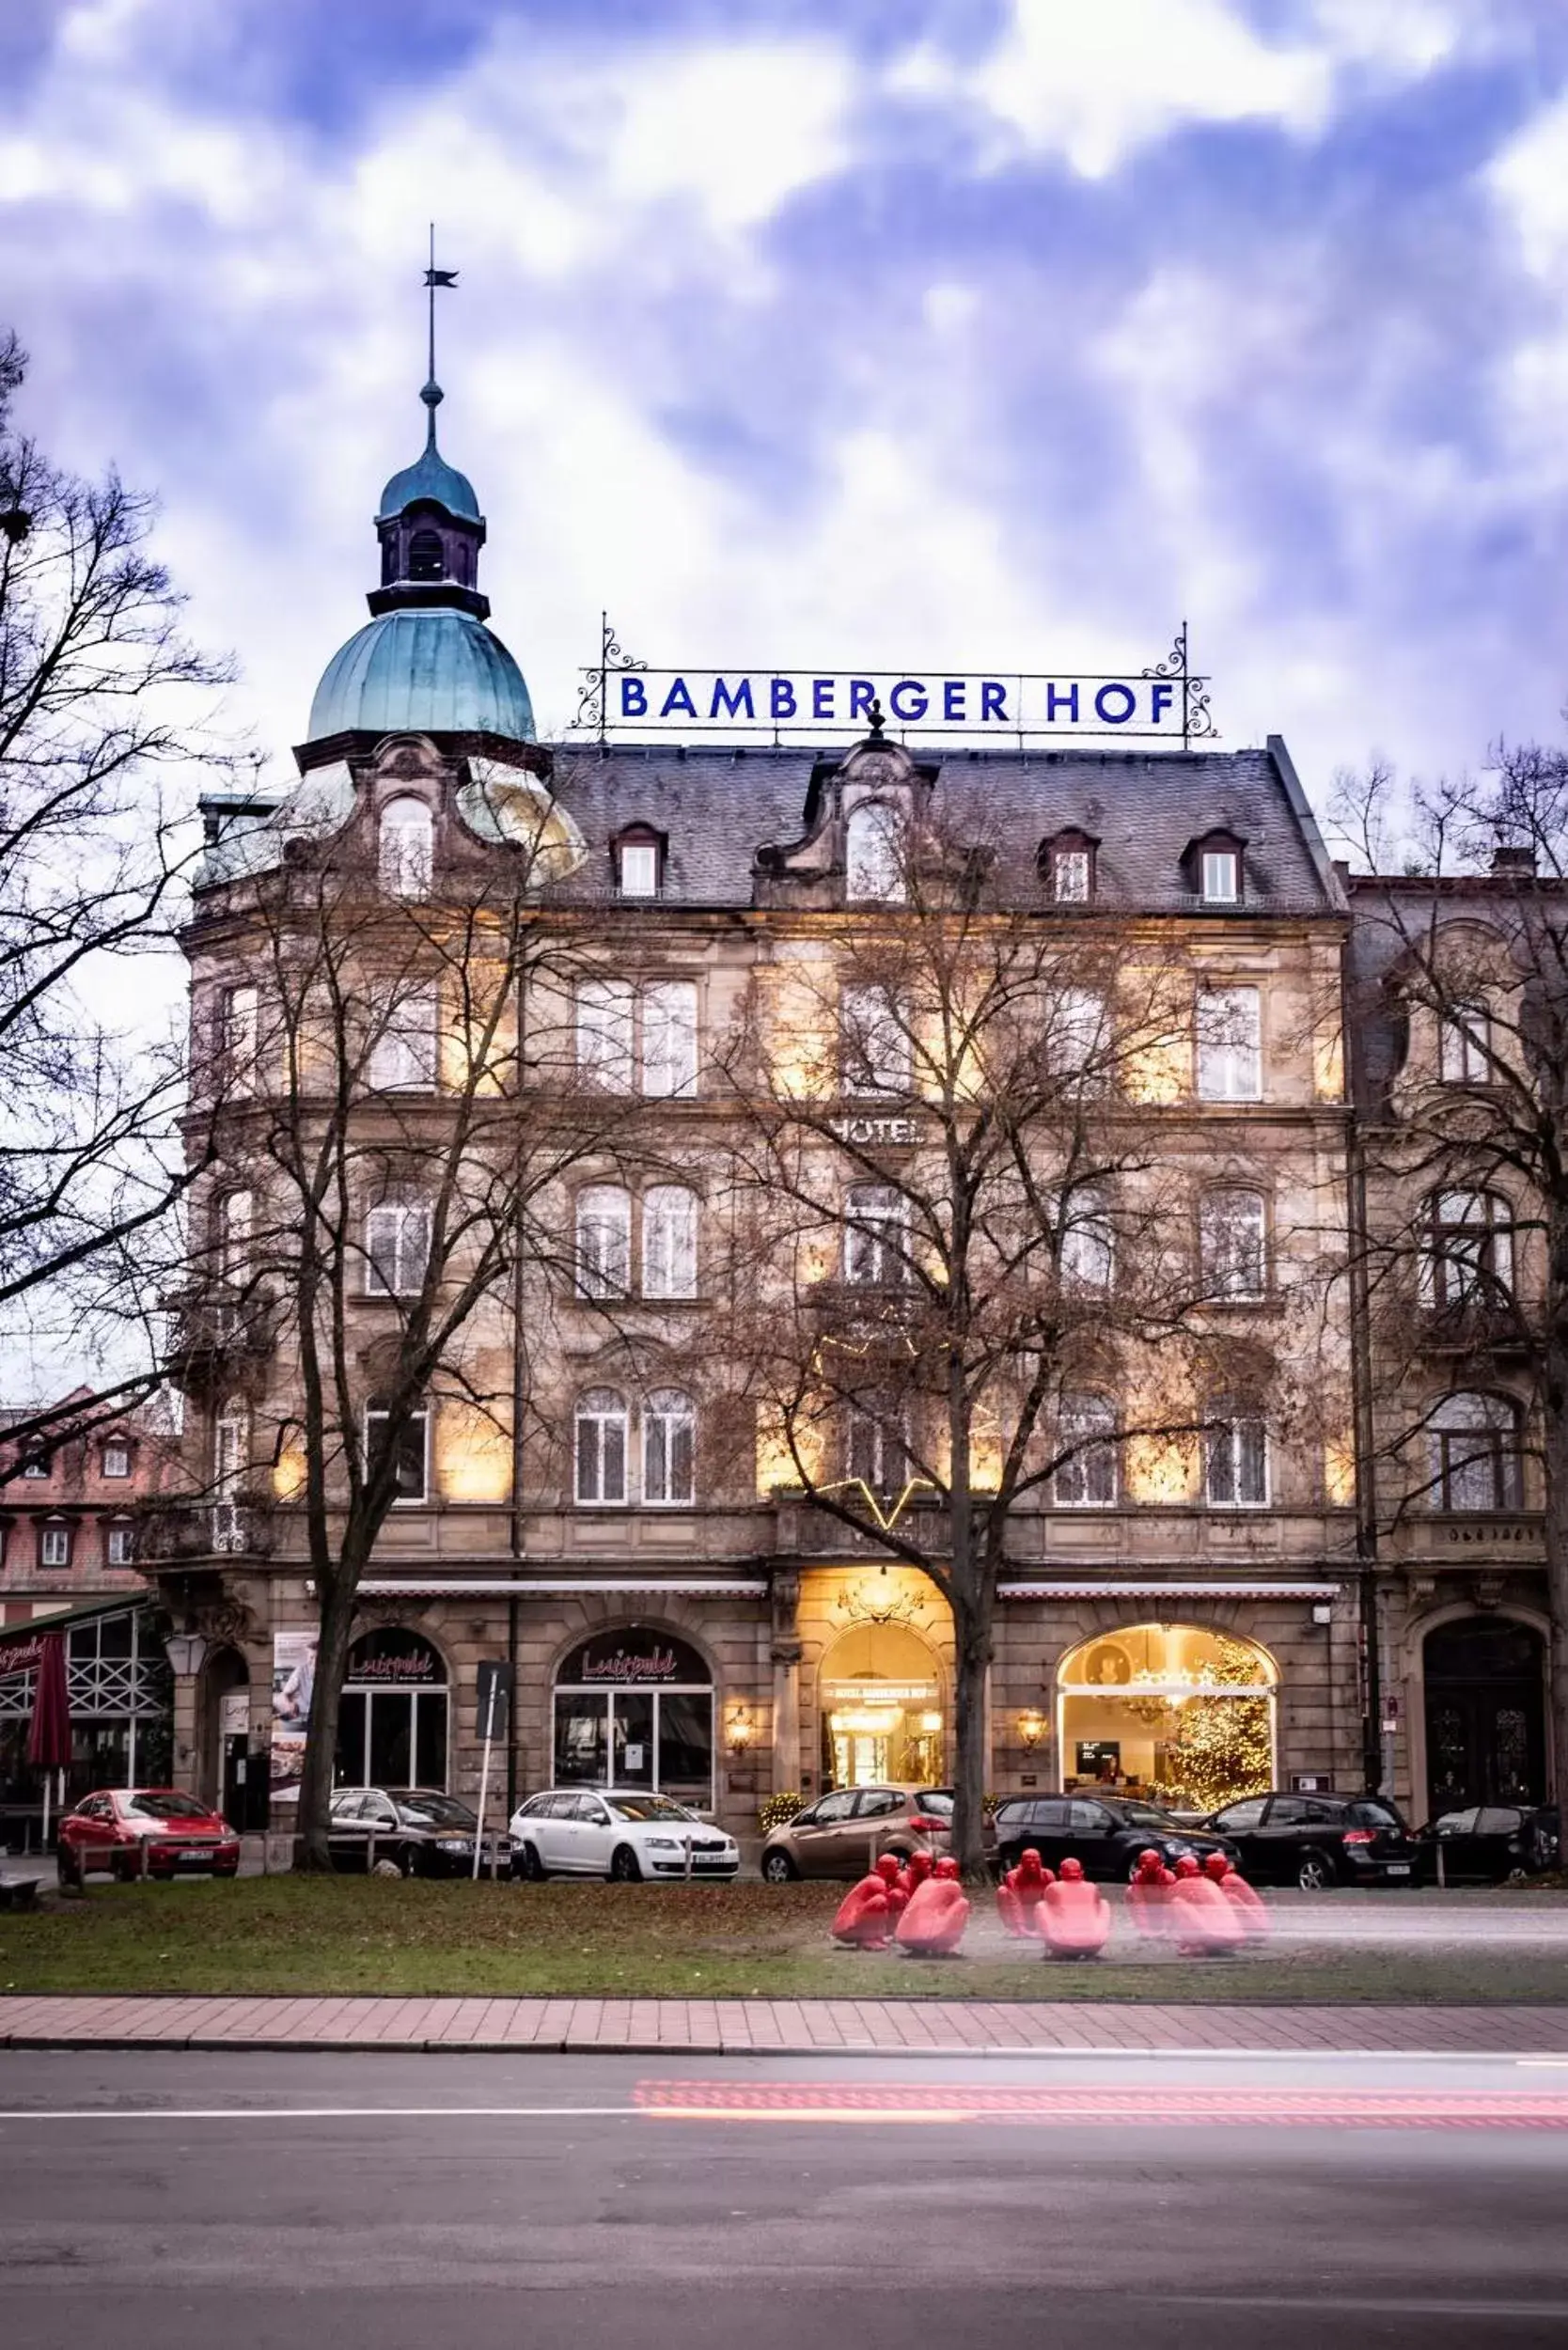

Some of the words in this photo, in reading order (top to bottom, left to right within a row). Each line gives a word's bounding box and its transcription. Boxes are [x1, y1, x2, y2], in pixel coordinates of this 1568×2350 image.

[621, 678, 1010, 721] BAMBERGER
[1047, 683, 1172, 724] HOF
[829, 1119, 924, 1142] HOTEL
